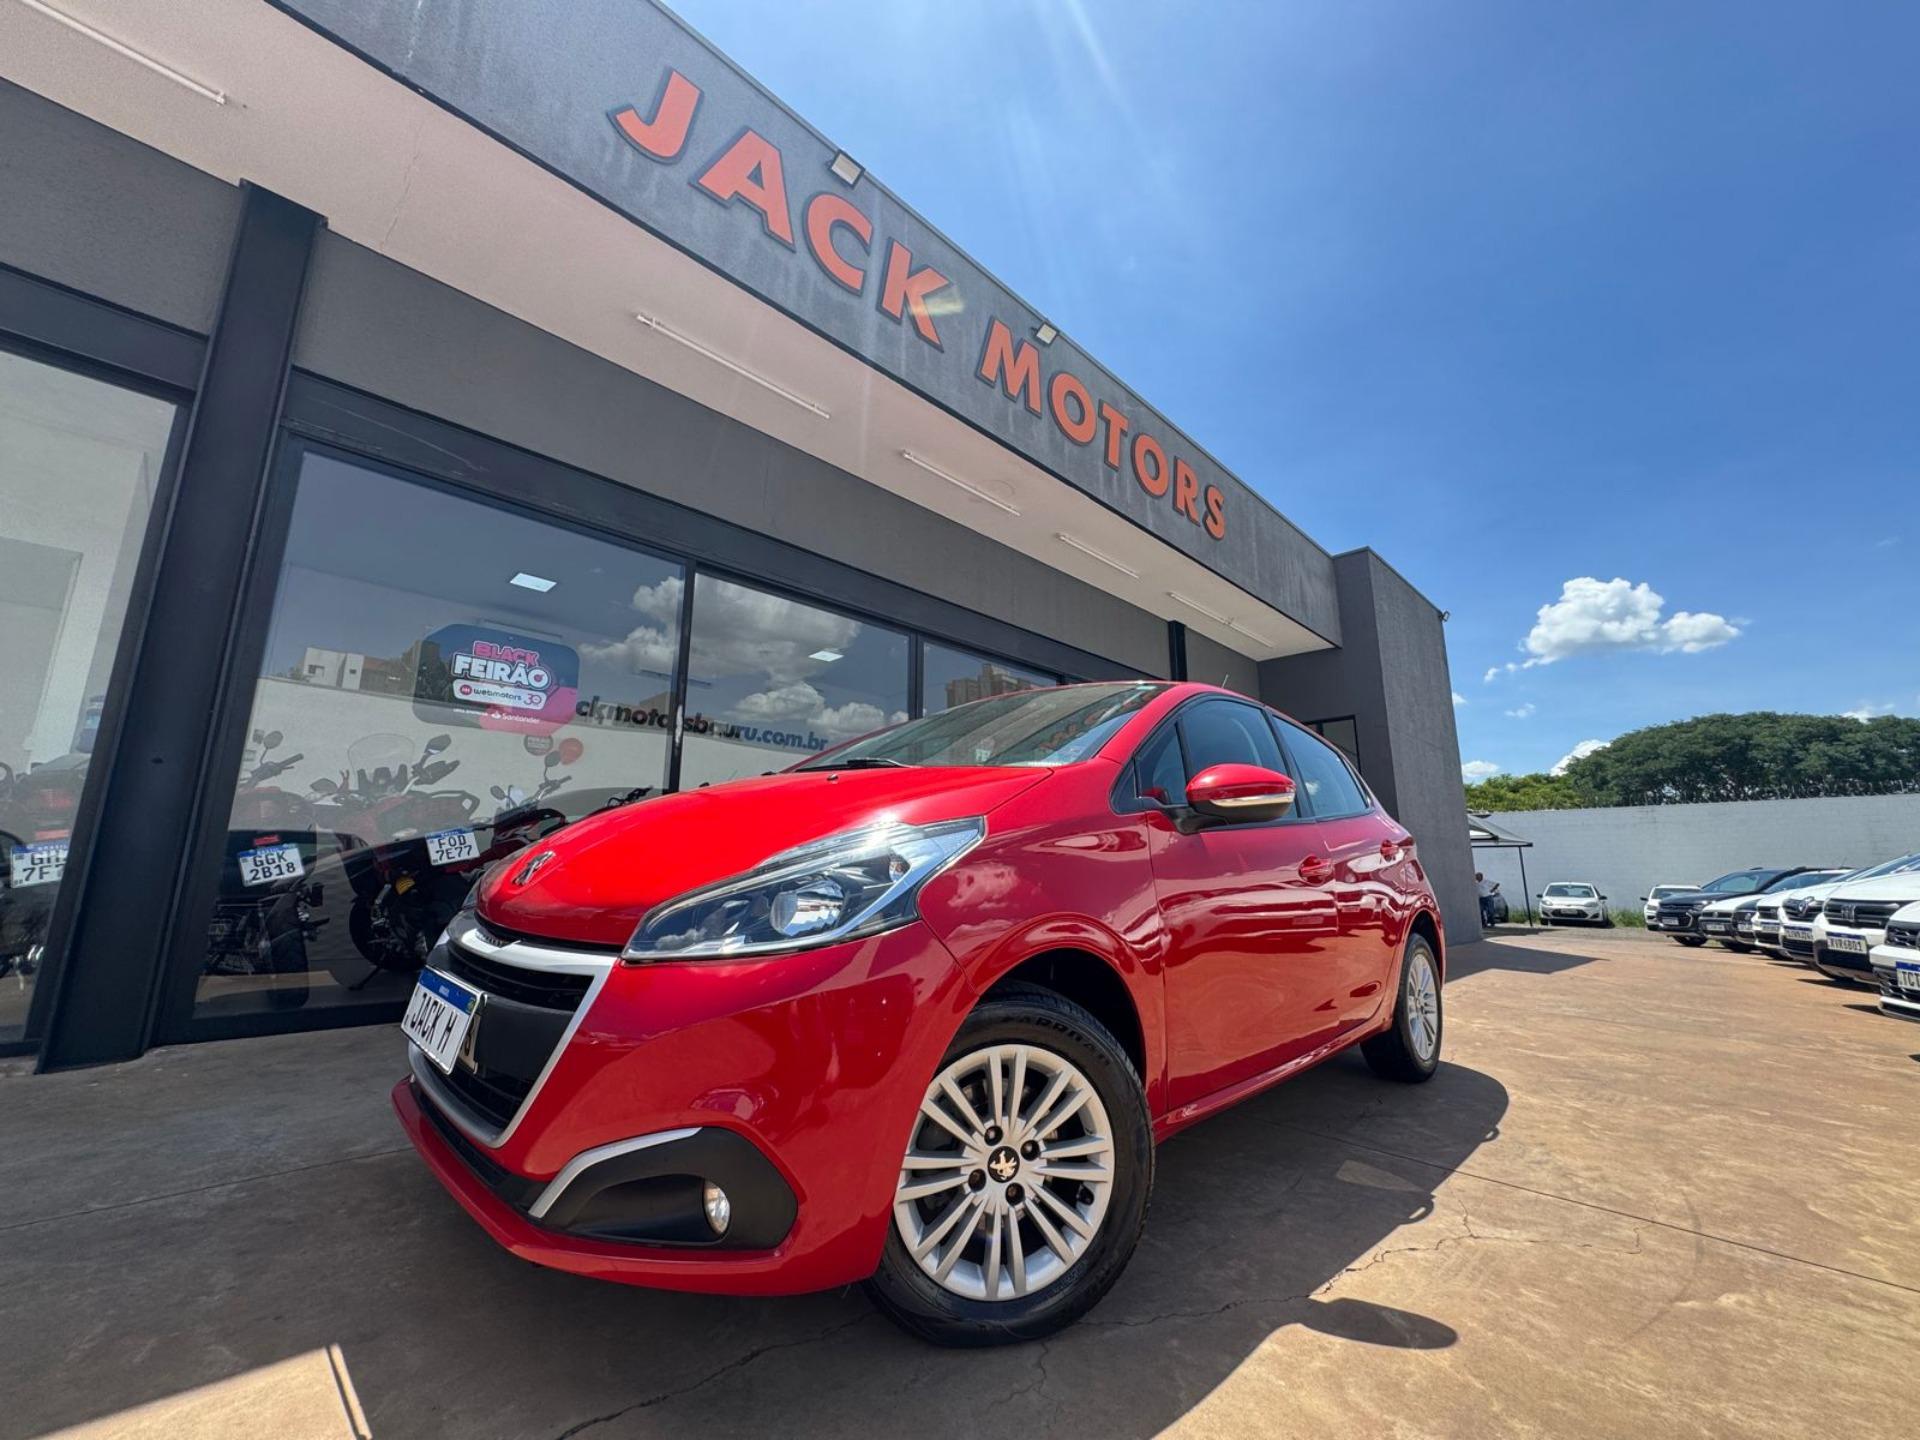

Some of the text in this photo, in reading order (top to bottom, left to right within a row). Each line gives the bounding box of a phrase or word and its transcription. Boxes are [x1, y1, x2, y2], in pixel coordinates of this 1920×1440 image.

[608, 68, 1225, 540] JACK MOTORS
[474, 642, 538, 666] BLACK
[454, 654, 549, 688] FEIRÃO
[473, 687, 522, 701] webmotors
[502, 713, 541, 724] Santander
[253, 851, 287, 867] GGK
[435, 845, 472, 861] 7E77
[250, 862, 295, 880] 2B18
[410, 991, 446, 1045] JACK
